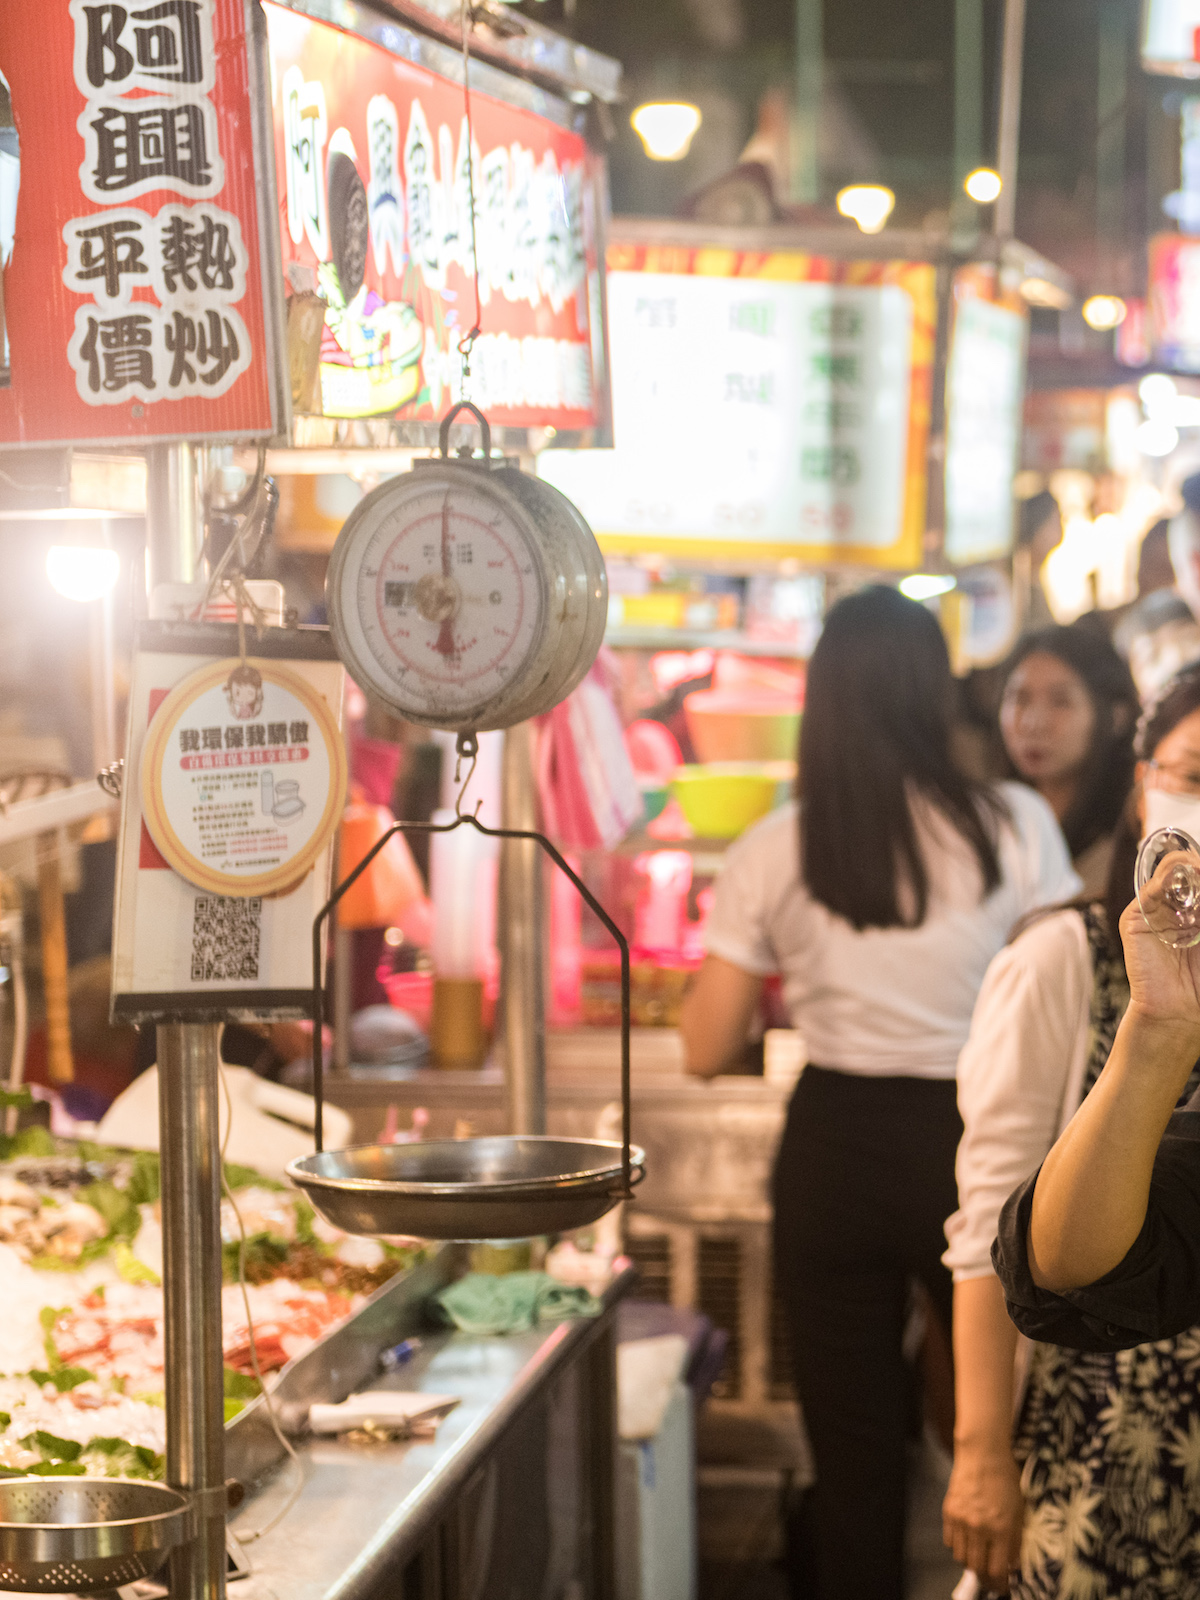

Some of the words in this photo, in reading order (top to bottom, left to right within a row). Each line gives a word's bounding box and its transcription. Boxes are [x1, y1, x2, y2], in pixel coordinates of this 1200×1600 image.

[86, 0, 213, 191] 阿興
[75, 218, 157, 394] 平價
[160, 213, 241, 389] 熱炒
[180, 721, 309, 752] 我環保我驕傲
